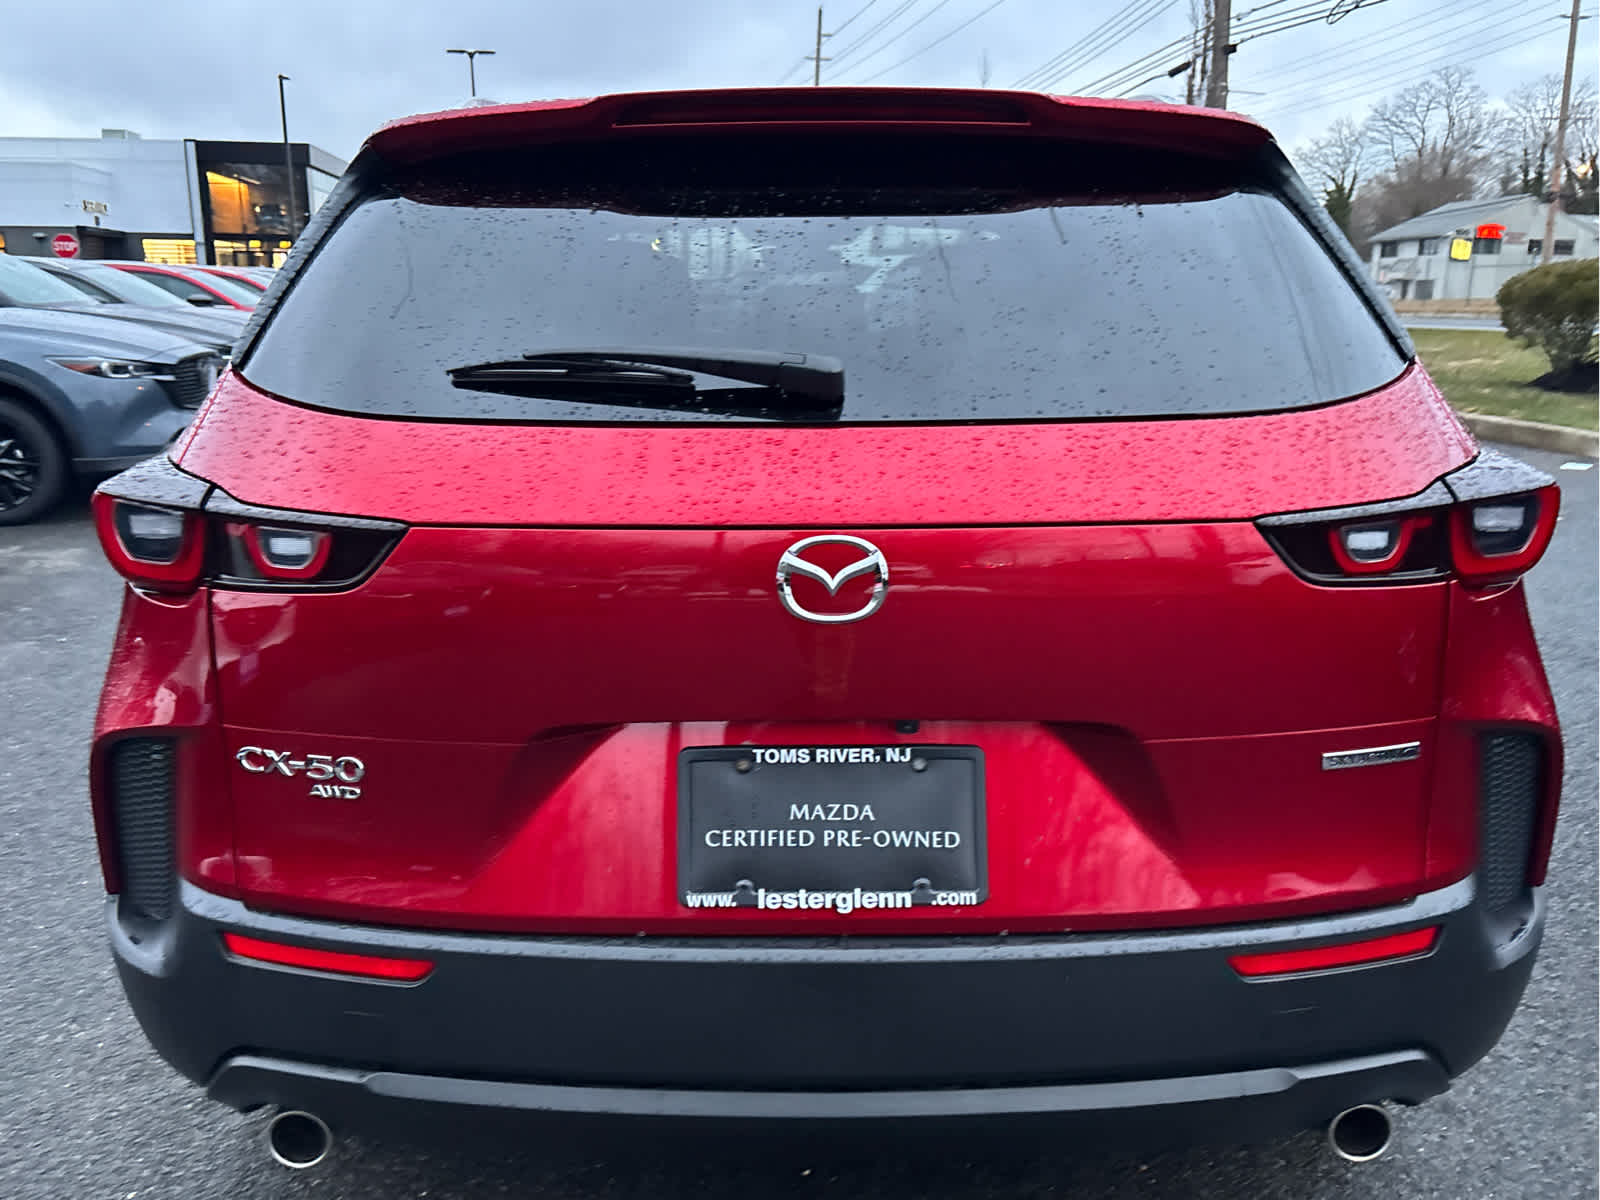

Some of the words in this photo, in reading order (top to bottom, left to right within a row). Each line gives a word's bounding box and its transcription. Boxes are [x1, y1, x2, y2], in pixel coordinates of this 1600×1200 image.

[53, 241, 78, 251] STOP
[752, 749, 810, 763] TOMS
[816, 748, 880, 763] RIVER,
[886, 748, 912, 762] NJ
[236, 746, 365, 783] CX-50
[309, 784, 361, 799] AWD
[789, 804, 876, 821] MAZDA
[705, 830, 815, 847] CERTIFIED
[823, 830, 961, 848] PRE-OWNED
[686, 895, 737, 907] www.
[758, 888, 912, 913] lesterglenn
[931, 890, 977, 905] .com
